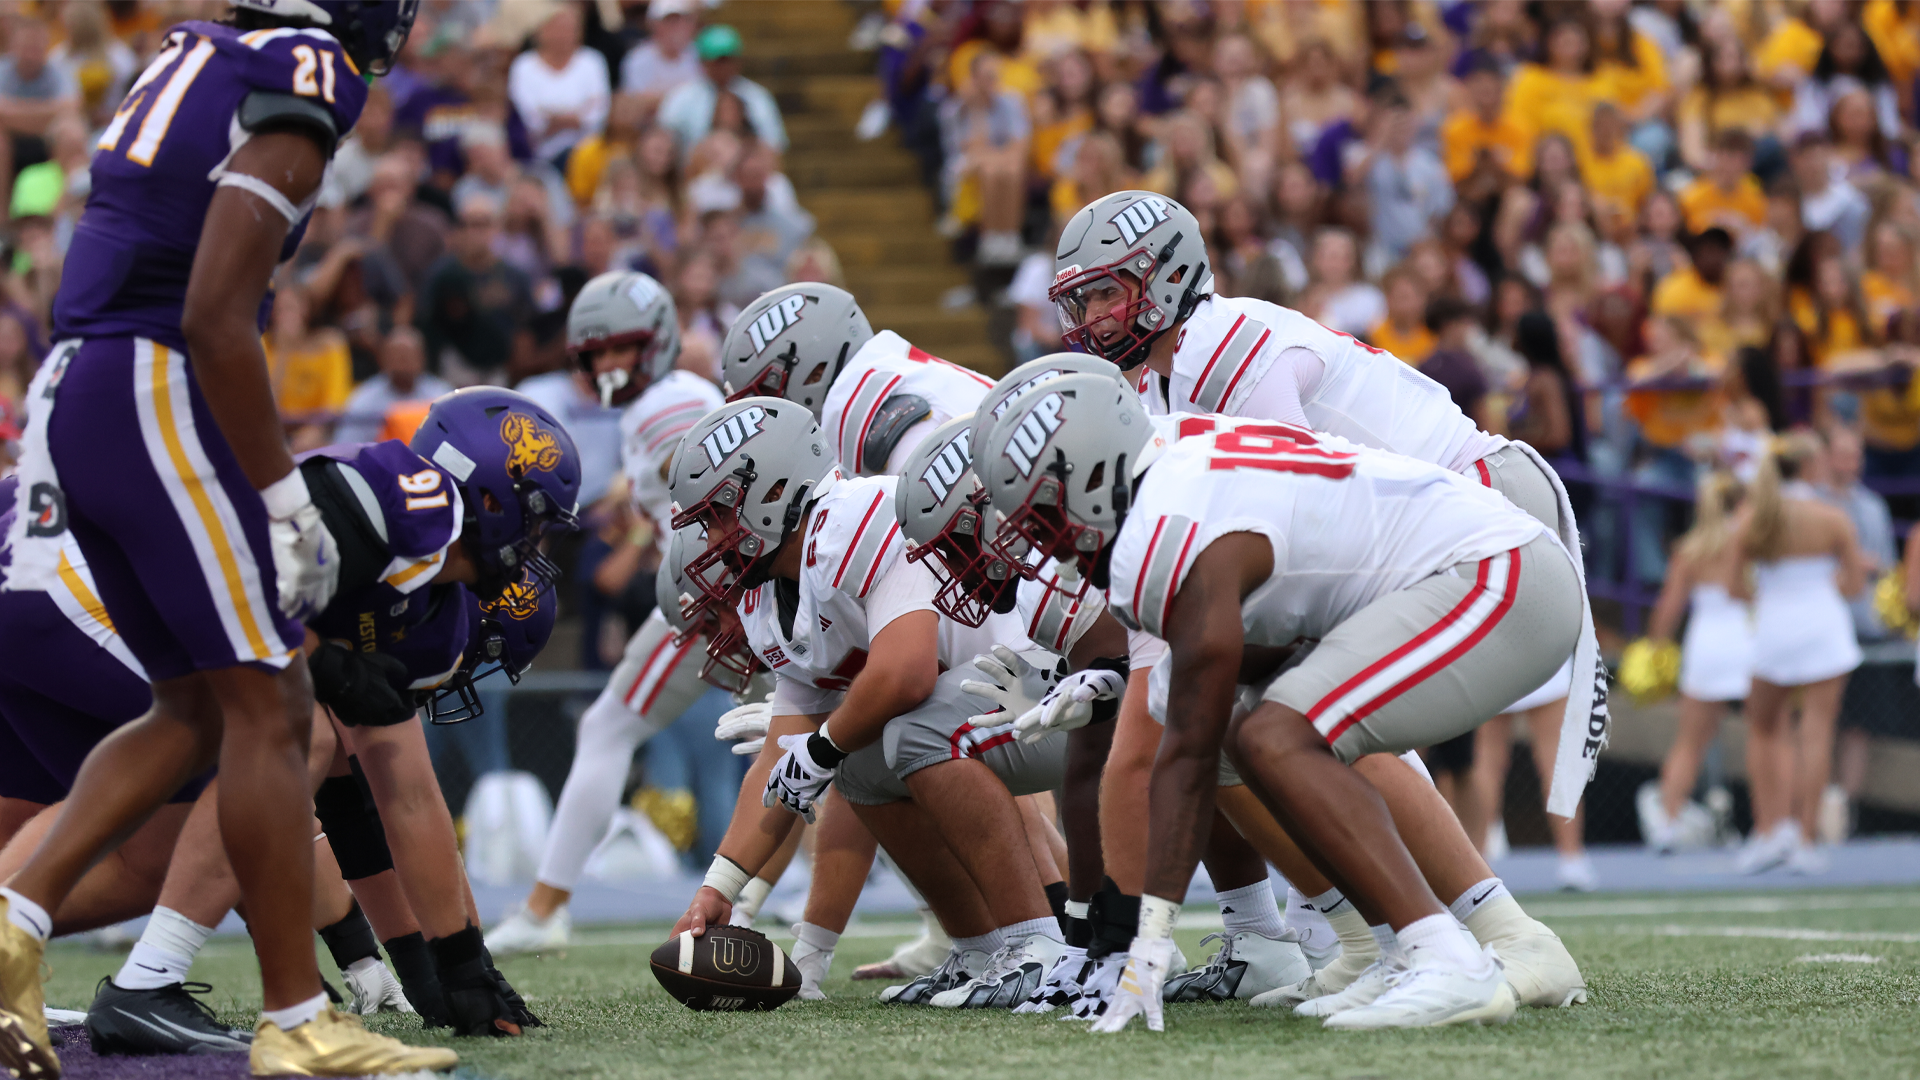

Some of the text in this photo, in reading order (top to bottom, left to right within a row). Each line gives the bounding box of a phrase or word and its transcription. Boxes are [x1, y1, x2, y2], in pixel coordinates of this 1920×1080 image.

[97, 31, 216, 168] 21
[292, 44, 335, 103] 21
[1109, 196, 1170, 248] IUP
[745, 293, 805, 357] IUP
[700, 405, 766, 470] IUP
[1003, 392, 1065, 480] IUP
[398, 468, 449, 511] 91
[359, 611, 376, 641] WEST
